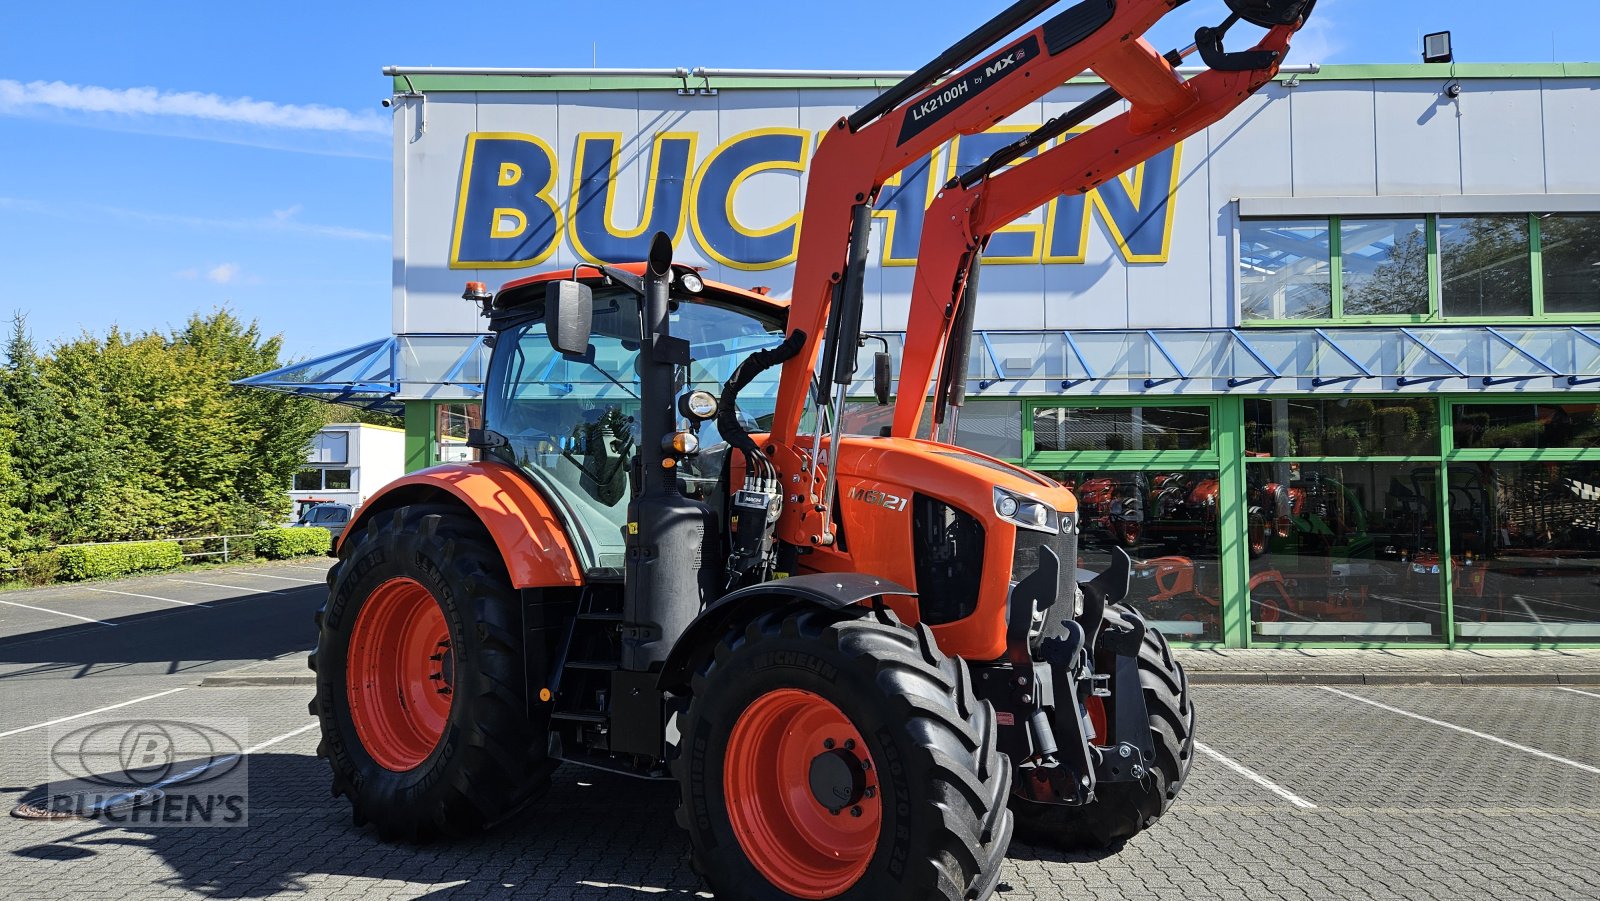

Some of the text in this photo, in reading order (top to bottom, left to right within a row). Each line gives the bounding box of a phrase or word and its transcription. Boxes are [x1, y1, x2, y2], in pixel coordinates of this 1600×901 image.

[912, 53, 1016, 121] LK2100H by MX
[847, 486, 908, 512] M6121
[753, 650, 839, 681] MICHELIN
